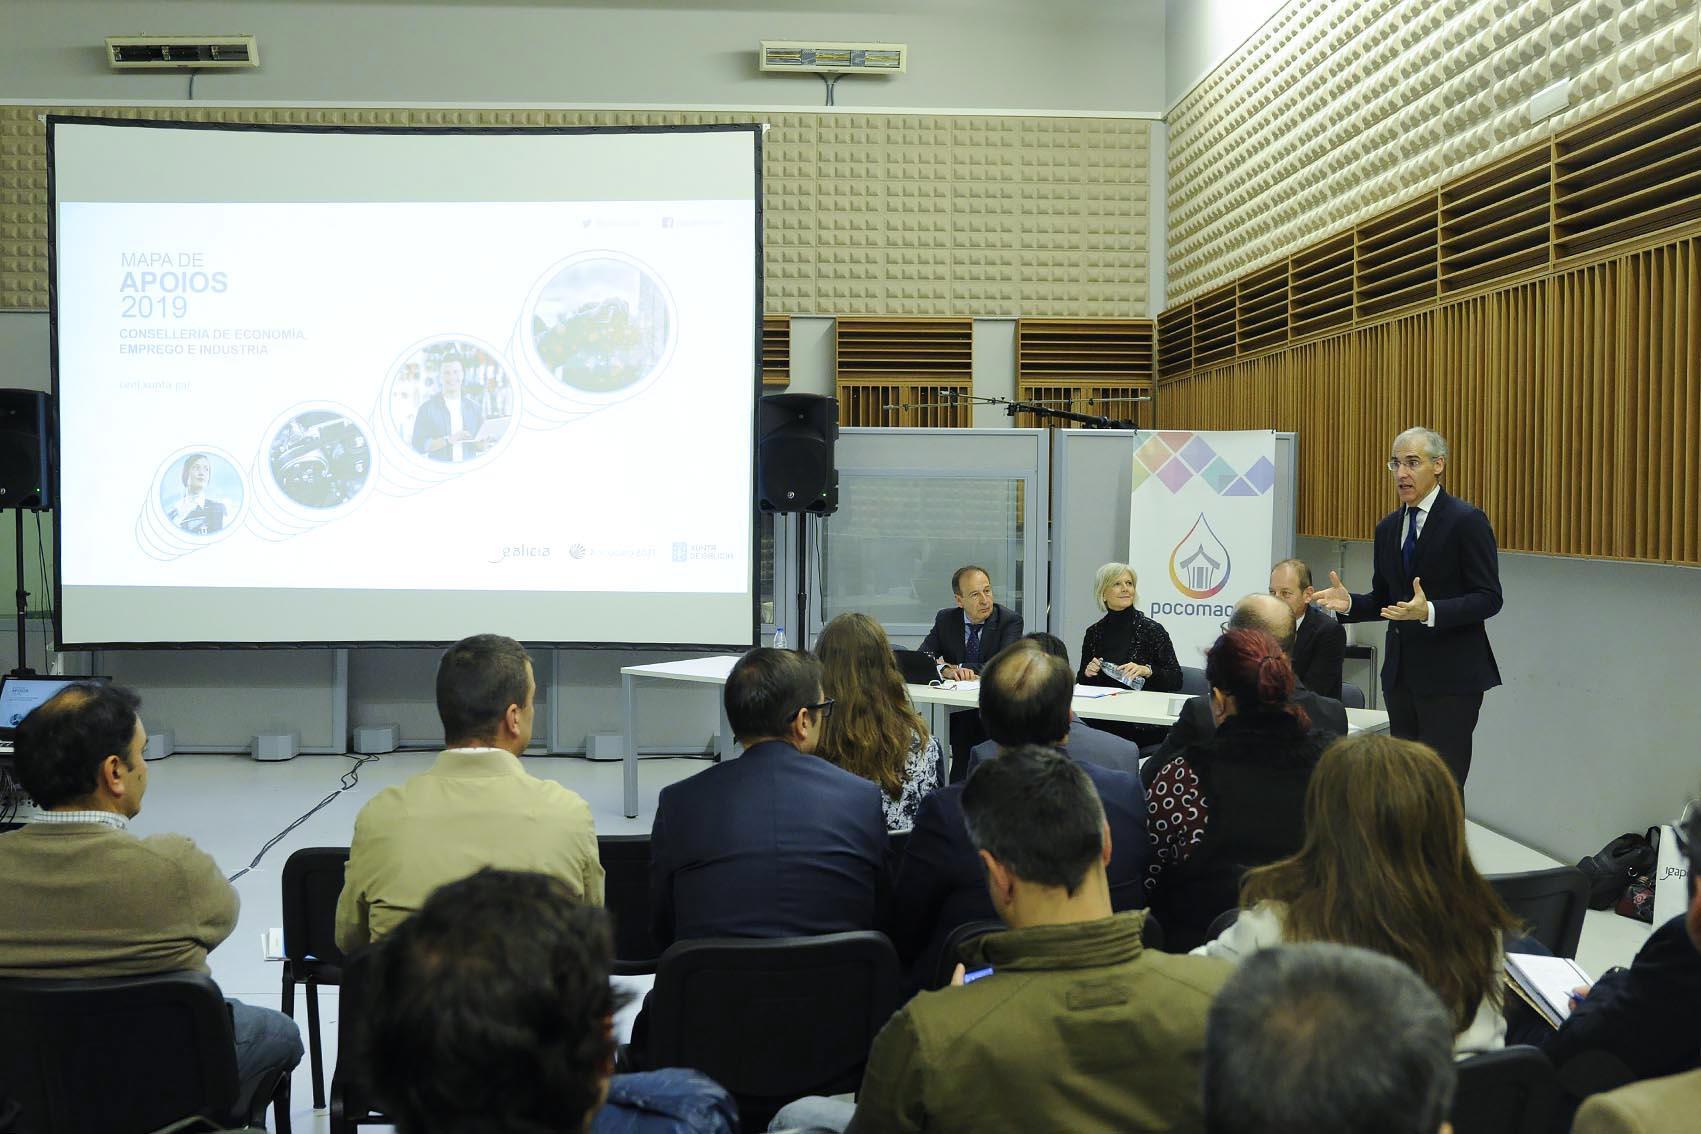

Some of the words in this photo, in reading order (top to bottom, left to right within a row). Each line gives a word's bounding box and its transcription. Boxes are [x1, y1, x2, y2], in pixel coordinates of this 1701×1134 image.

[121, 252, 173, 268] MAPA
[178, 252, 204, 268] DE
[119, 271, 229, 293] APOIOS
[121, 295, 188, 318] 2019
[213, 328, 231, 340] DE
[119, 344, 184, 355] EMPREGO
[187, 344, 196, 355] E
[1150, 602, 1235, 618] pocomac
[1660, 866, 1689, 880] igap
